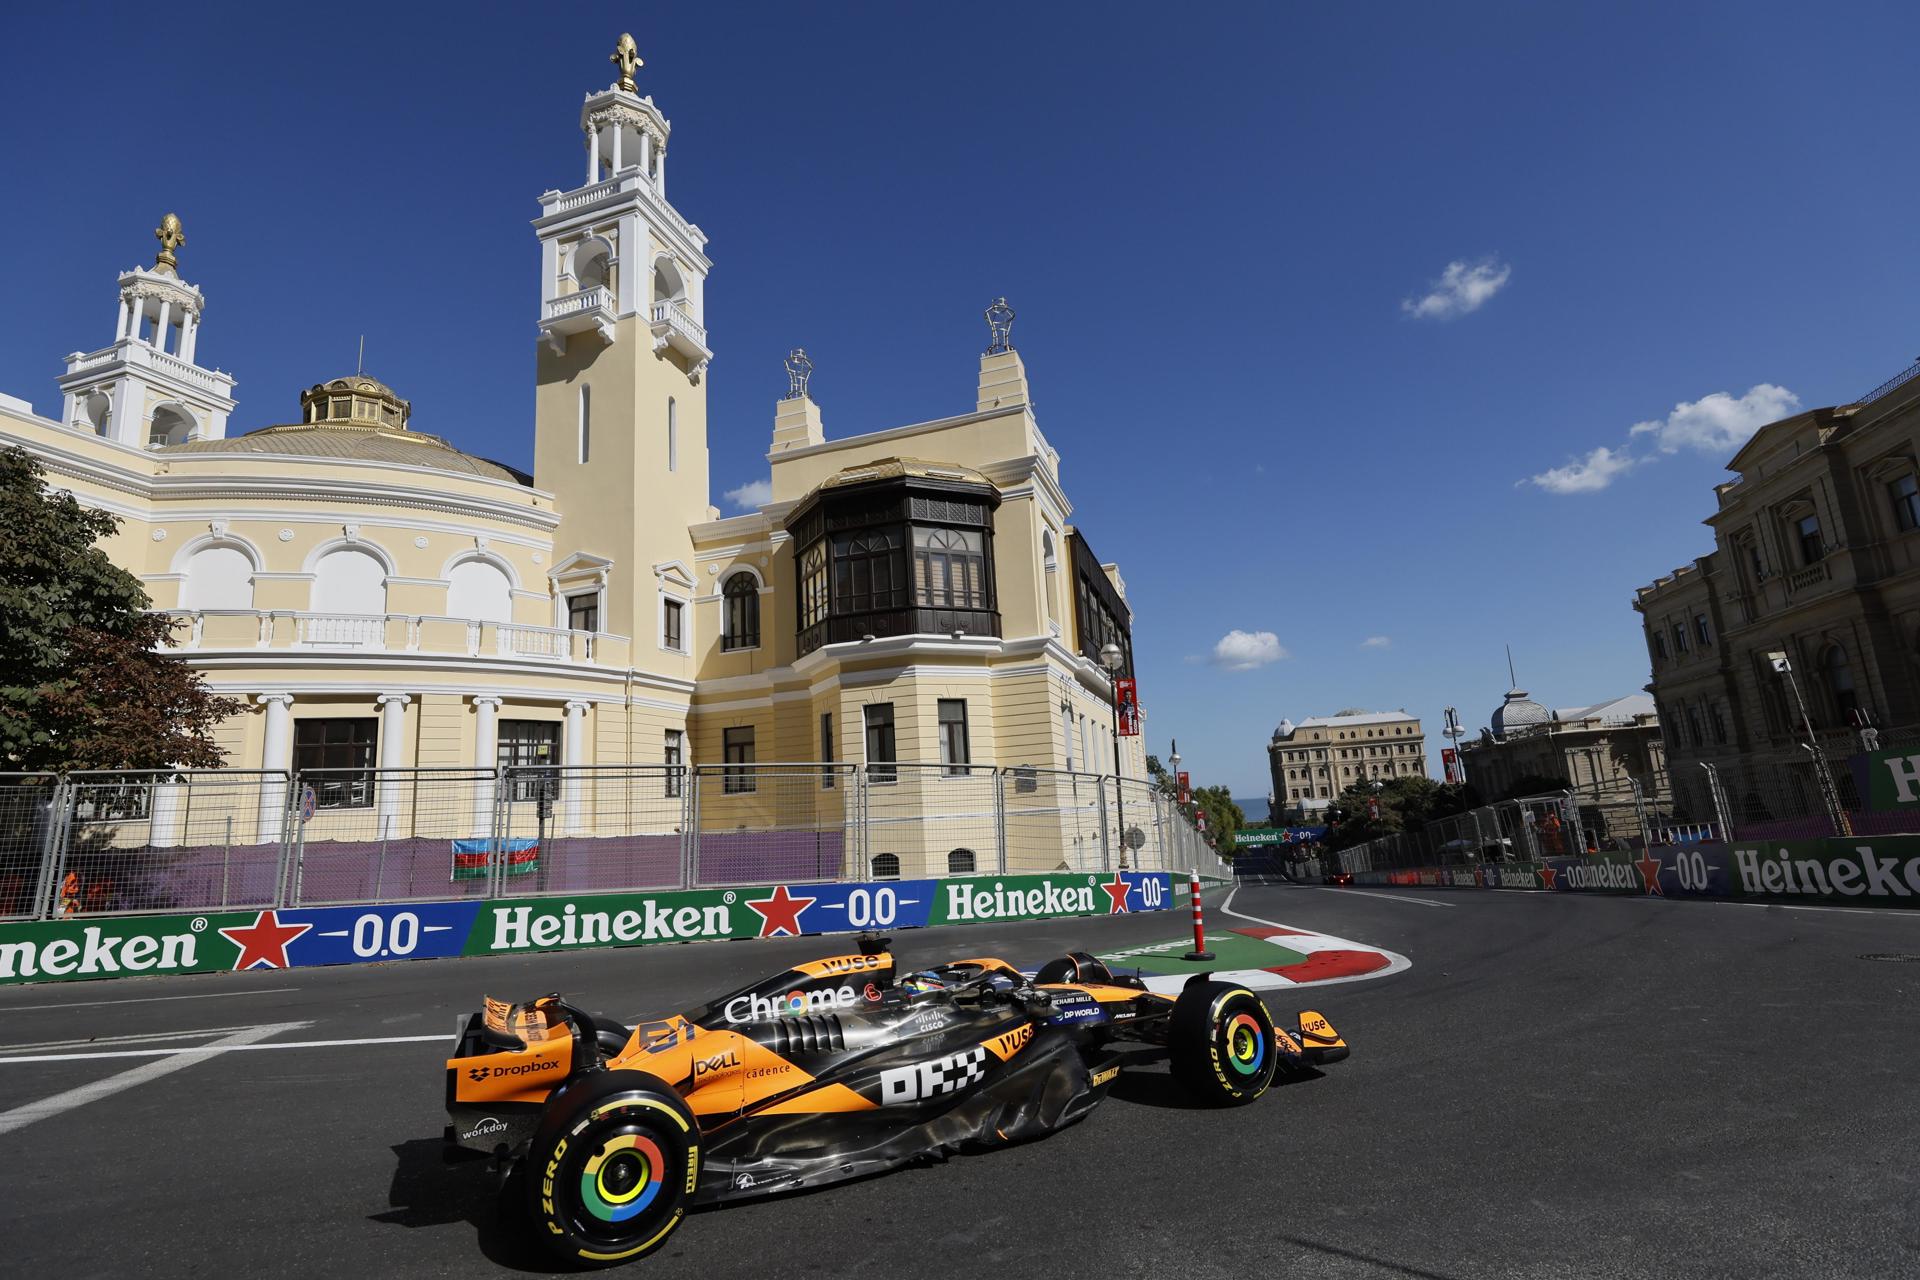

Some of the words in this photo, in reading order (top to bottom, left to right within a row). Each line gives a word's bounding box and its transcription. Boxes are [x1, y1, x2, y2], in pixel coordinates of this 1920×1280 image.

[1235, 833, 1277, 843] Heineken
[1299, 830, 1312, 840] 00
[1500, 868, 1537, 888] Heineken
[1676, 851, 1708, 891] 0.0
[490, 899, 733, 950] Heineken
[848, 887, 896, 927] 0.0
[946, 881, 1096, 921] Heineken
[1142, 877, 1162, 907] 0.0
[353, 911, 419, 958] 0.0
[724, 985, 856, 1024] Chrome
[1064, 1010, 1075, 1019] DP
[1075, 1008, 1100, 1017] WORLD
[1076, 995, 1092, 1003] MILLE
[494, 1059, 559, 1078] Dropbox
[695, 1052, 741, 1076] DELL
[880, 1047, 986, 1106] OKX
[1210, 1047, 1233, 1090] ZERO
[462, 1121, 508, 1140] workday
[542, 1138, 568, 1216] ZERO
[685, 1145, 698, 1194] PIRELLI
